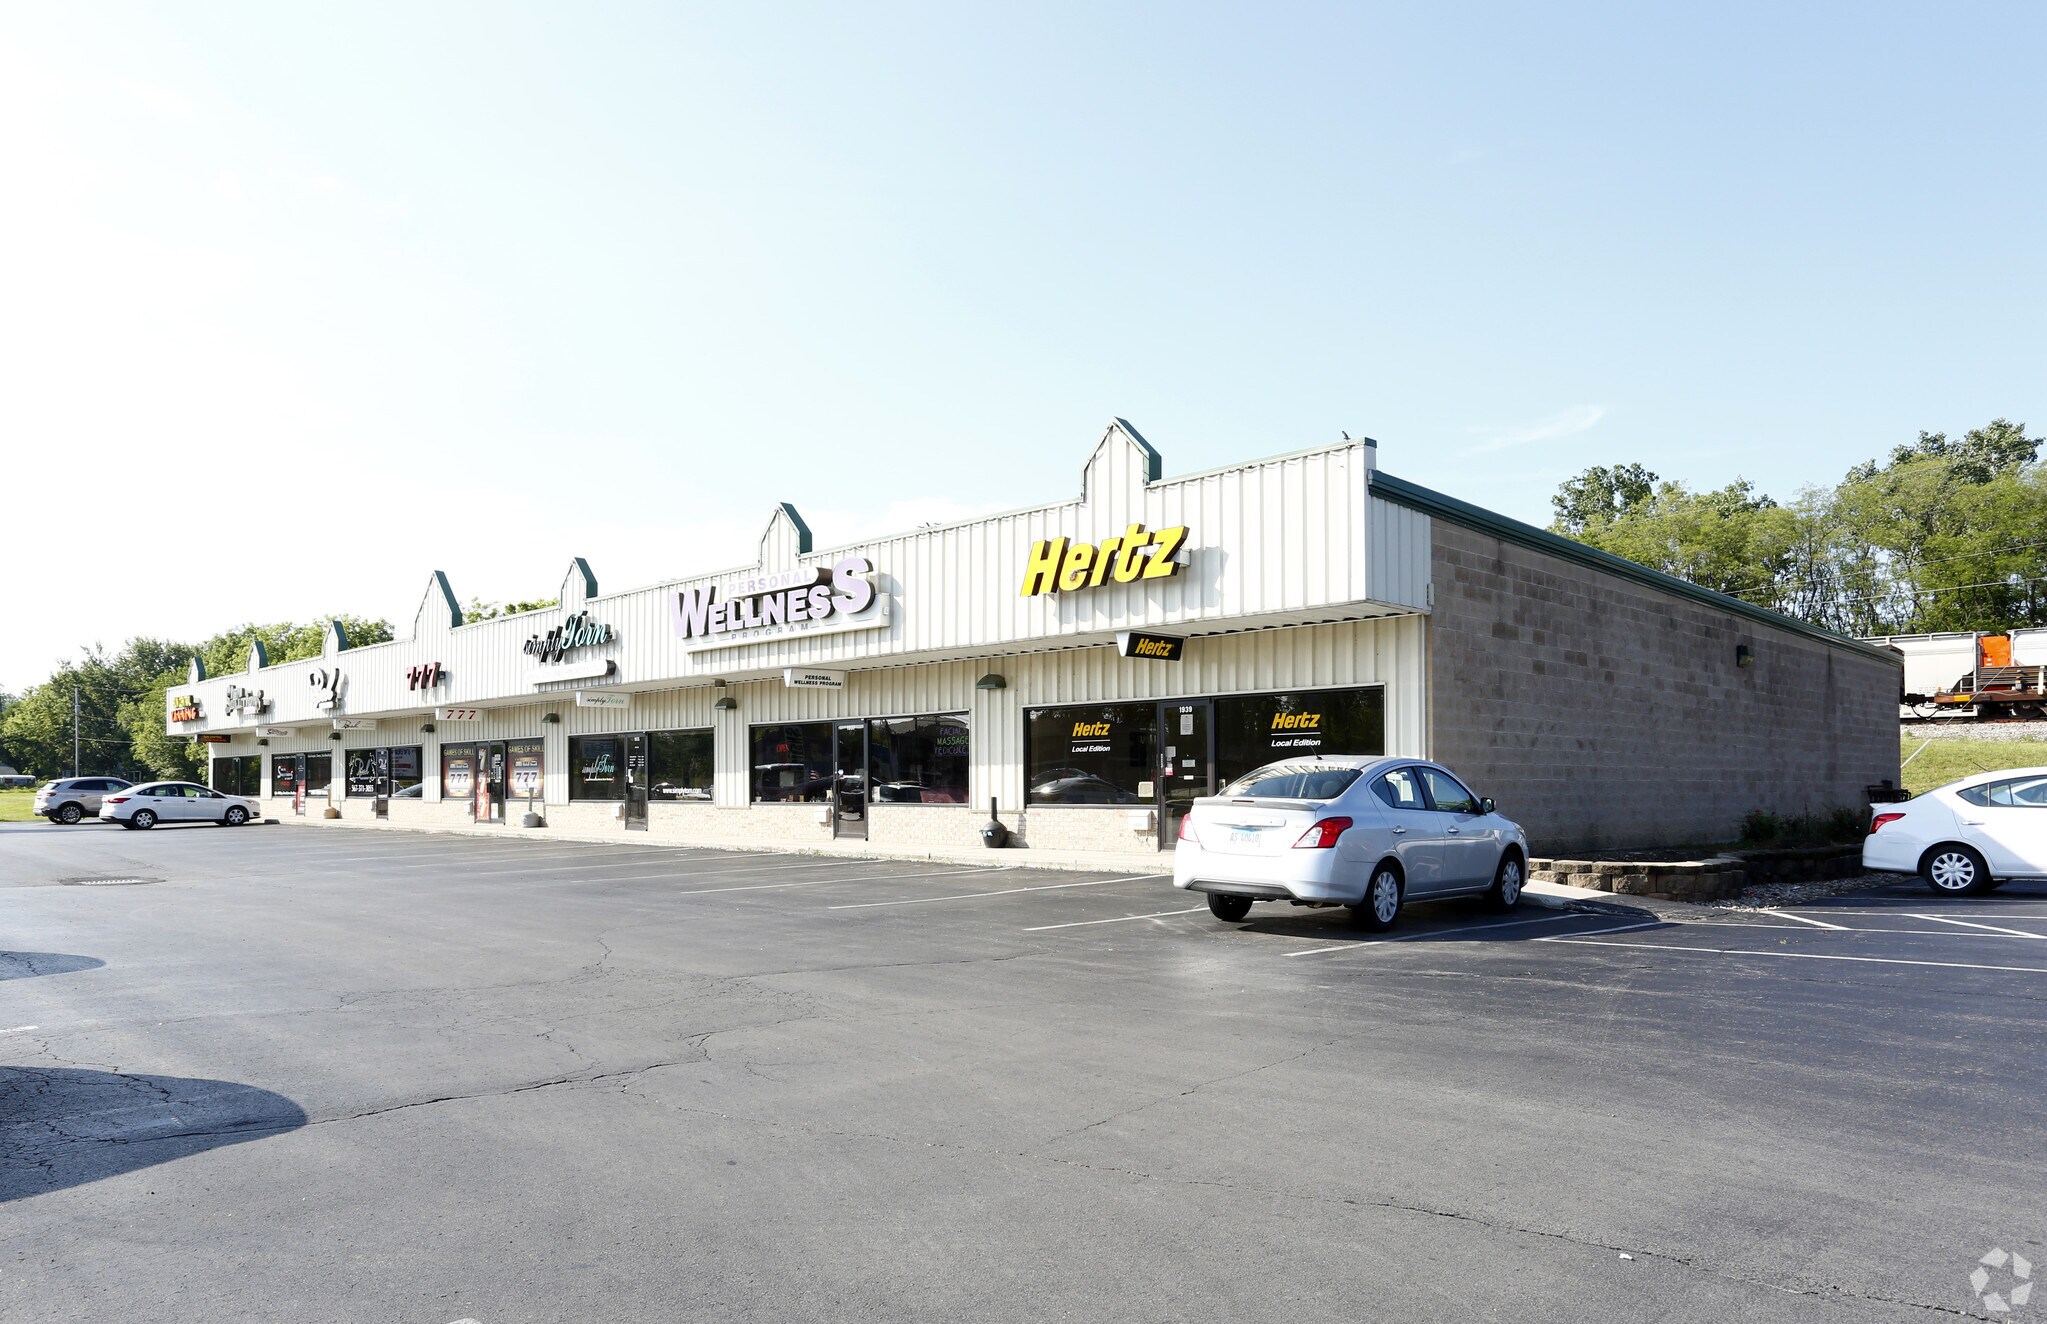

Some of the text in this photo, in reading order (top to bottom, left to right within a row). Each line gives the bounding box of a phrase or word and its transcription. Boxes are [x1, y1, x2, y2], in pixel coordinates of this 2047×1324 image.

[1020, 523, 1190, 597] Hertz
[728, 570, 812, 596] PERSONAL
[670, 557, 874, 639] WELLNESS
[731, 622, 809, 641] PROGRAM
[1135, 638, 1173, 657] Hertz
[1179, 706, 1193, 714] 1939
[1271, 711, 1321, 729] Hertz
[1072, 721, 1111, 737] Hertz
[936, 735, 969, 746] MASSAGE
[1271, 738, 1321, 747] Local Edition
[443, 748, 474, 757] GAMES OF SKILL
[508, 745, 523, 754] GAMES
[531, 744, 544, 752] SKILL
[1071, 745, 1088, 753] Local
[516, 772, 537, 783] 777
